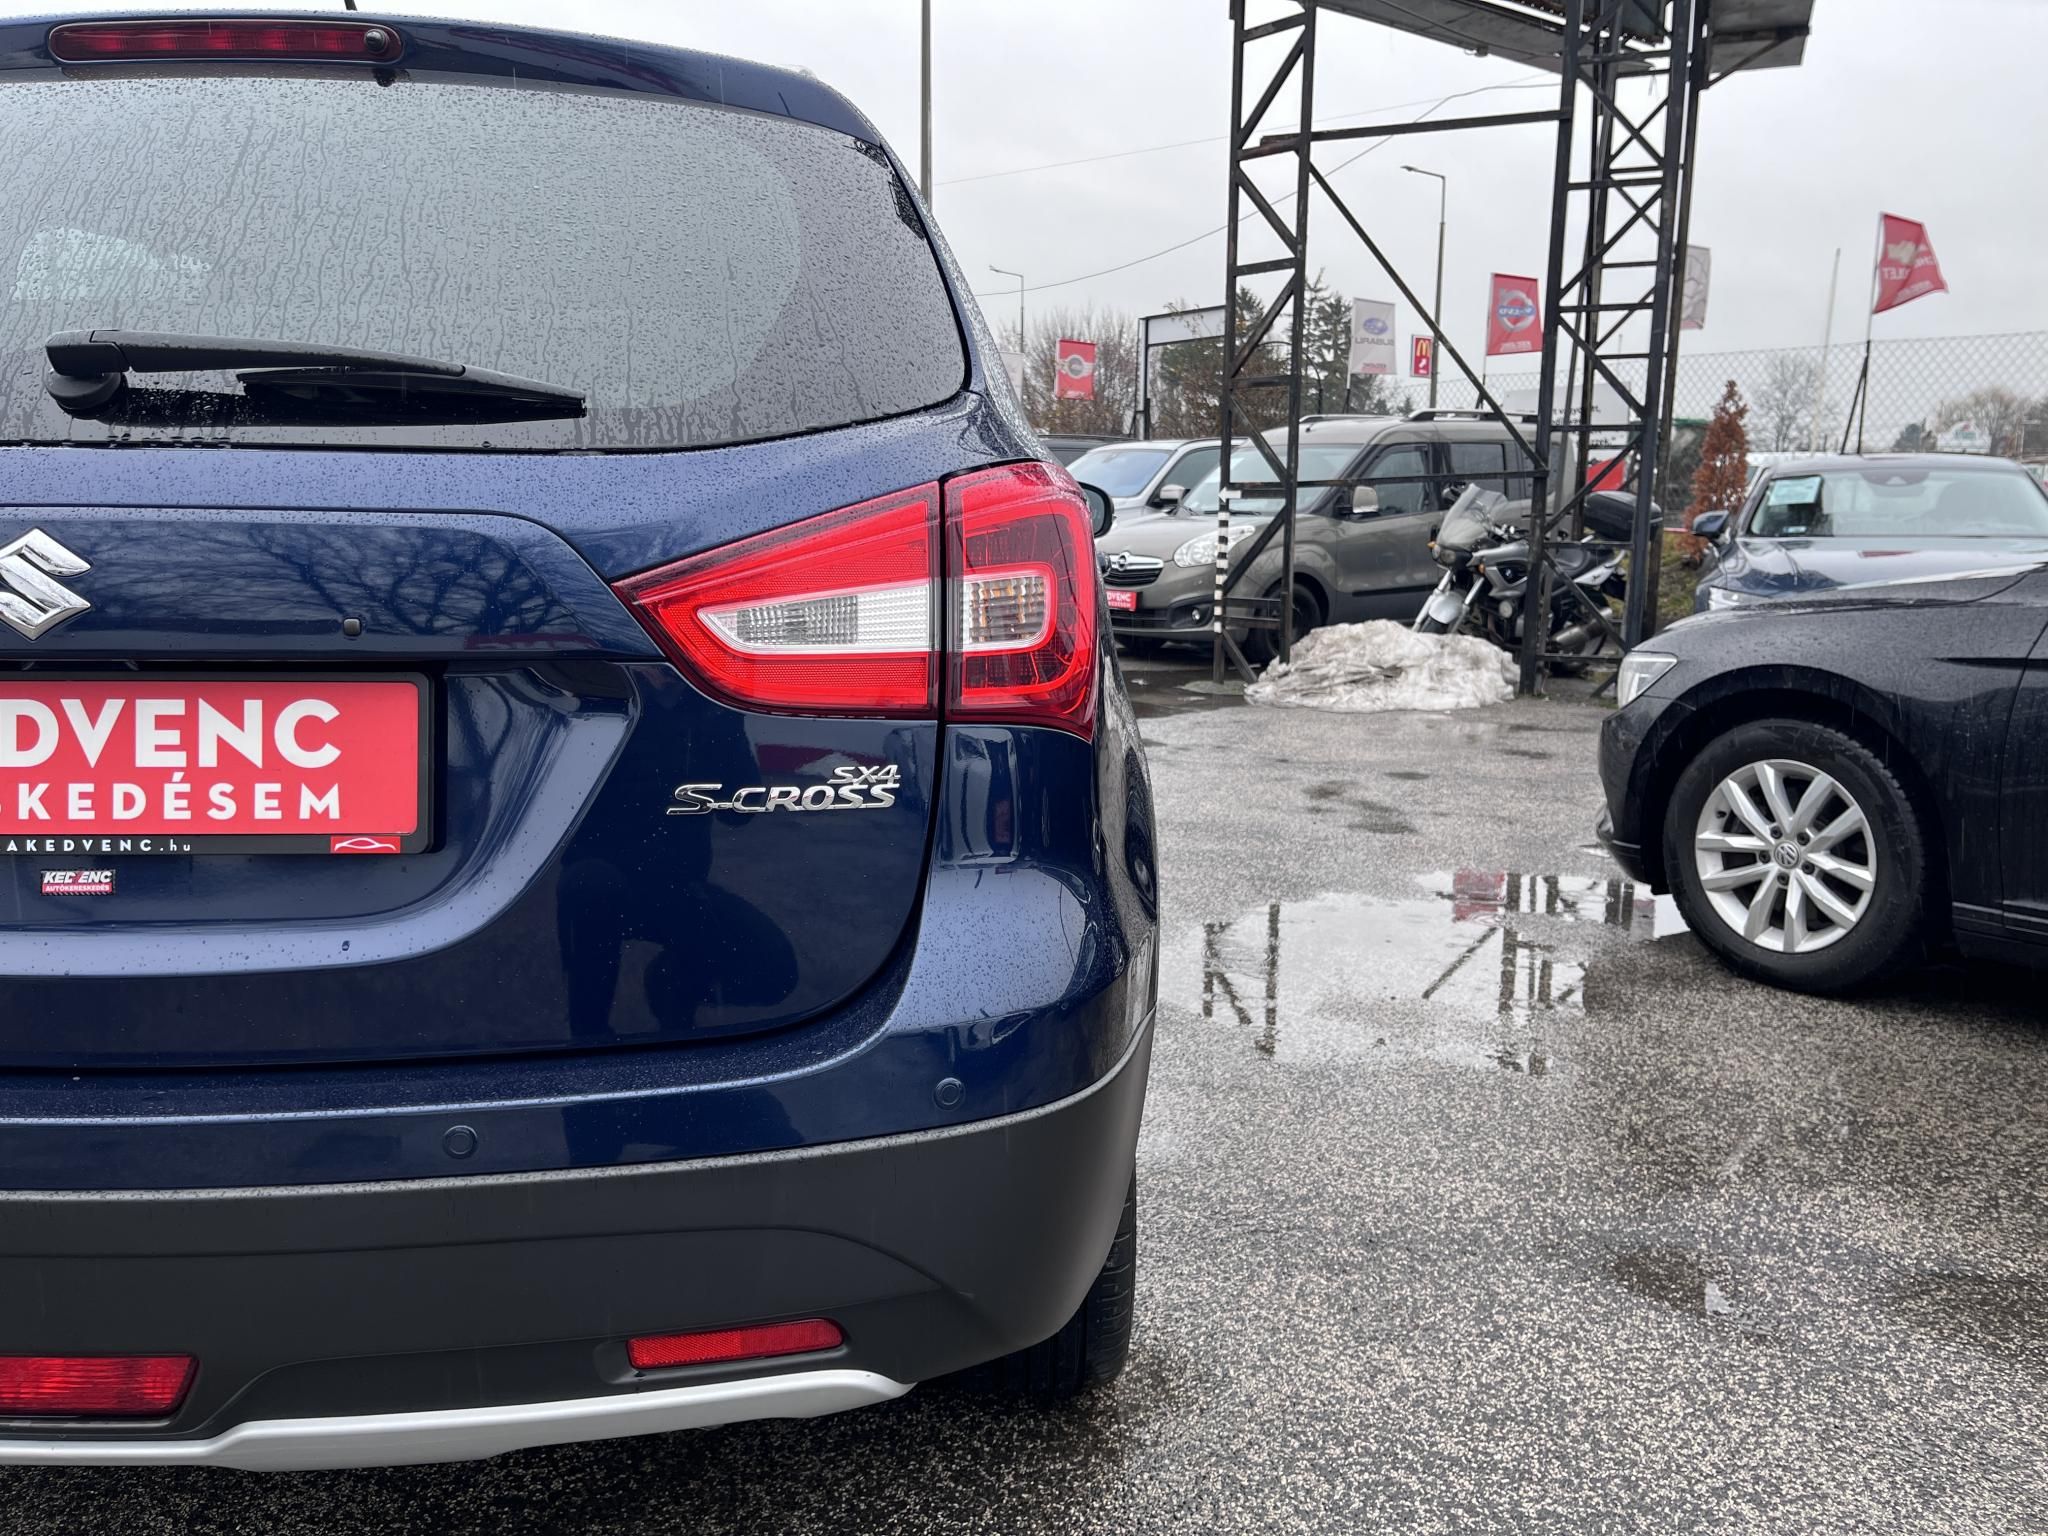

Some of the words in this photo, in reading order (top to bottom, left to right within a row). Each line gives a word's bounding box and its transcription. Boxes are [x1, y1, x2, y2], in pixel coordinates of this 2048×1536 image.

[0, 698, 342, 768] DVENC
[827, 764, 901, 785] SX4
[0, 772, 341, 821] KEDÉSEM
[666, 783, 900, 815] S-CROSS
[6, 838, 191, 852] AKEDVENC.hu
